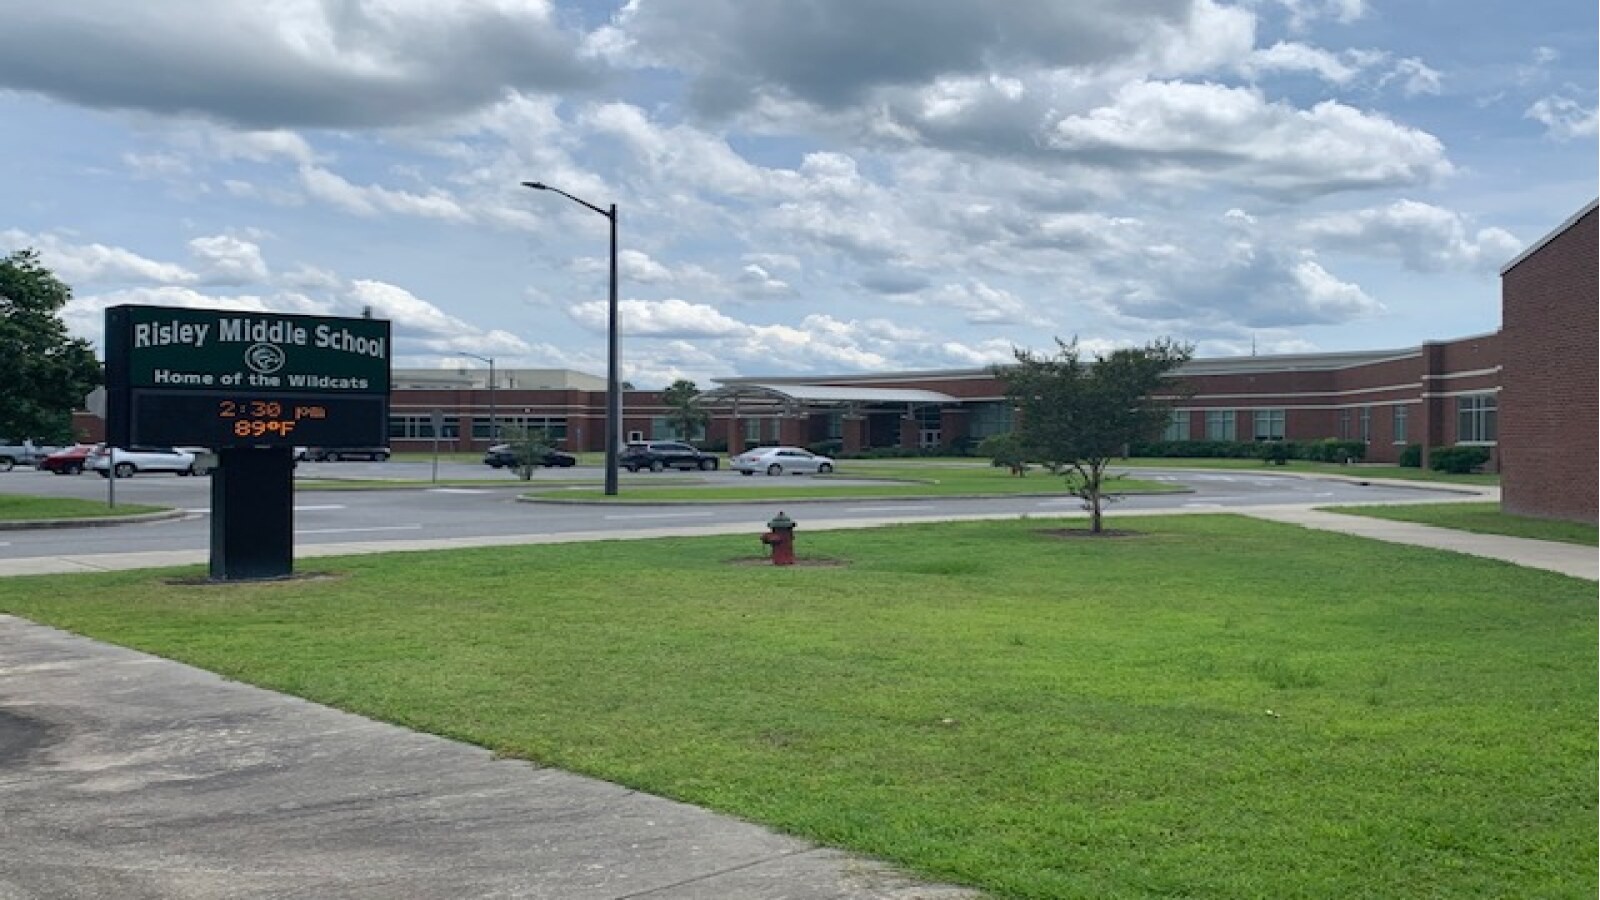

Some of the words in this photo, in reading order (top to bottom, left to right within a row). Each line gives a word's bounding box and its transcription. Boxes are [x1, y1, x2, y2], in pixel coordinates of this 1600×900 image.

[134, 320, 210, 348] Risley
[219, 318, 307, 346] Middle
[315, 324, 385, 358] School
[154, 368, 214, 385] Home
[221, 372, 243, 385] of
[248, 373, 281, 387] the
[287, 374, 369, 389] Wildcats
[219, 400, 281, 418] 2:30
[294, 405, 327, 420] pm
